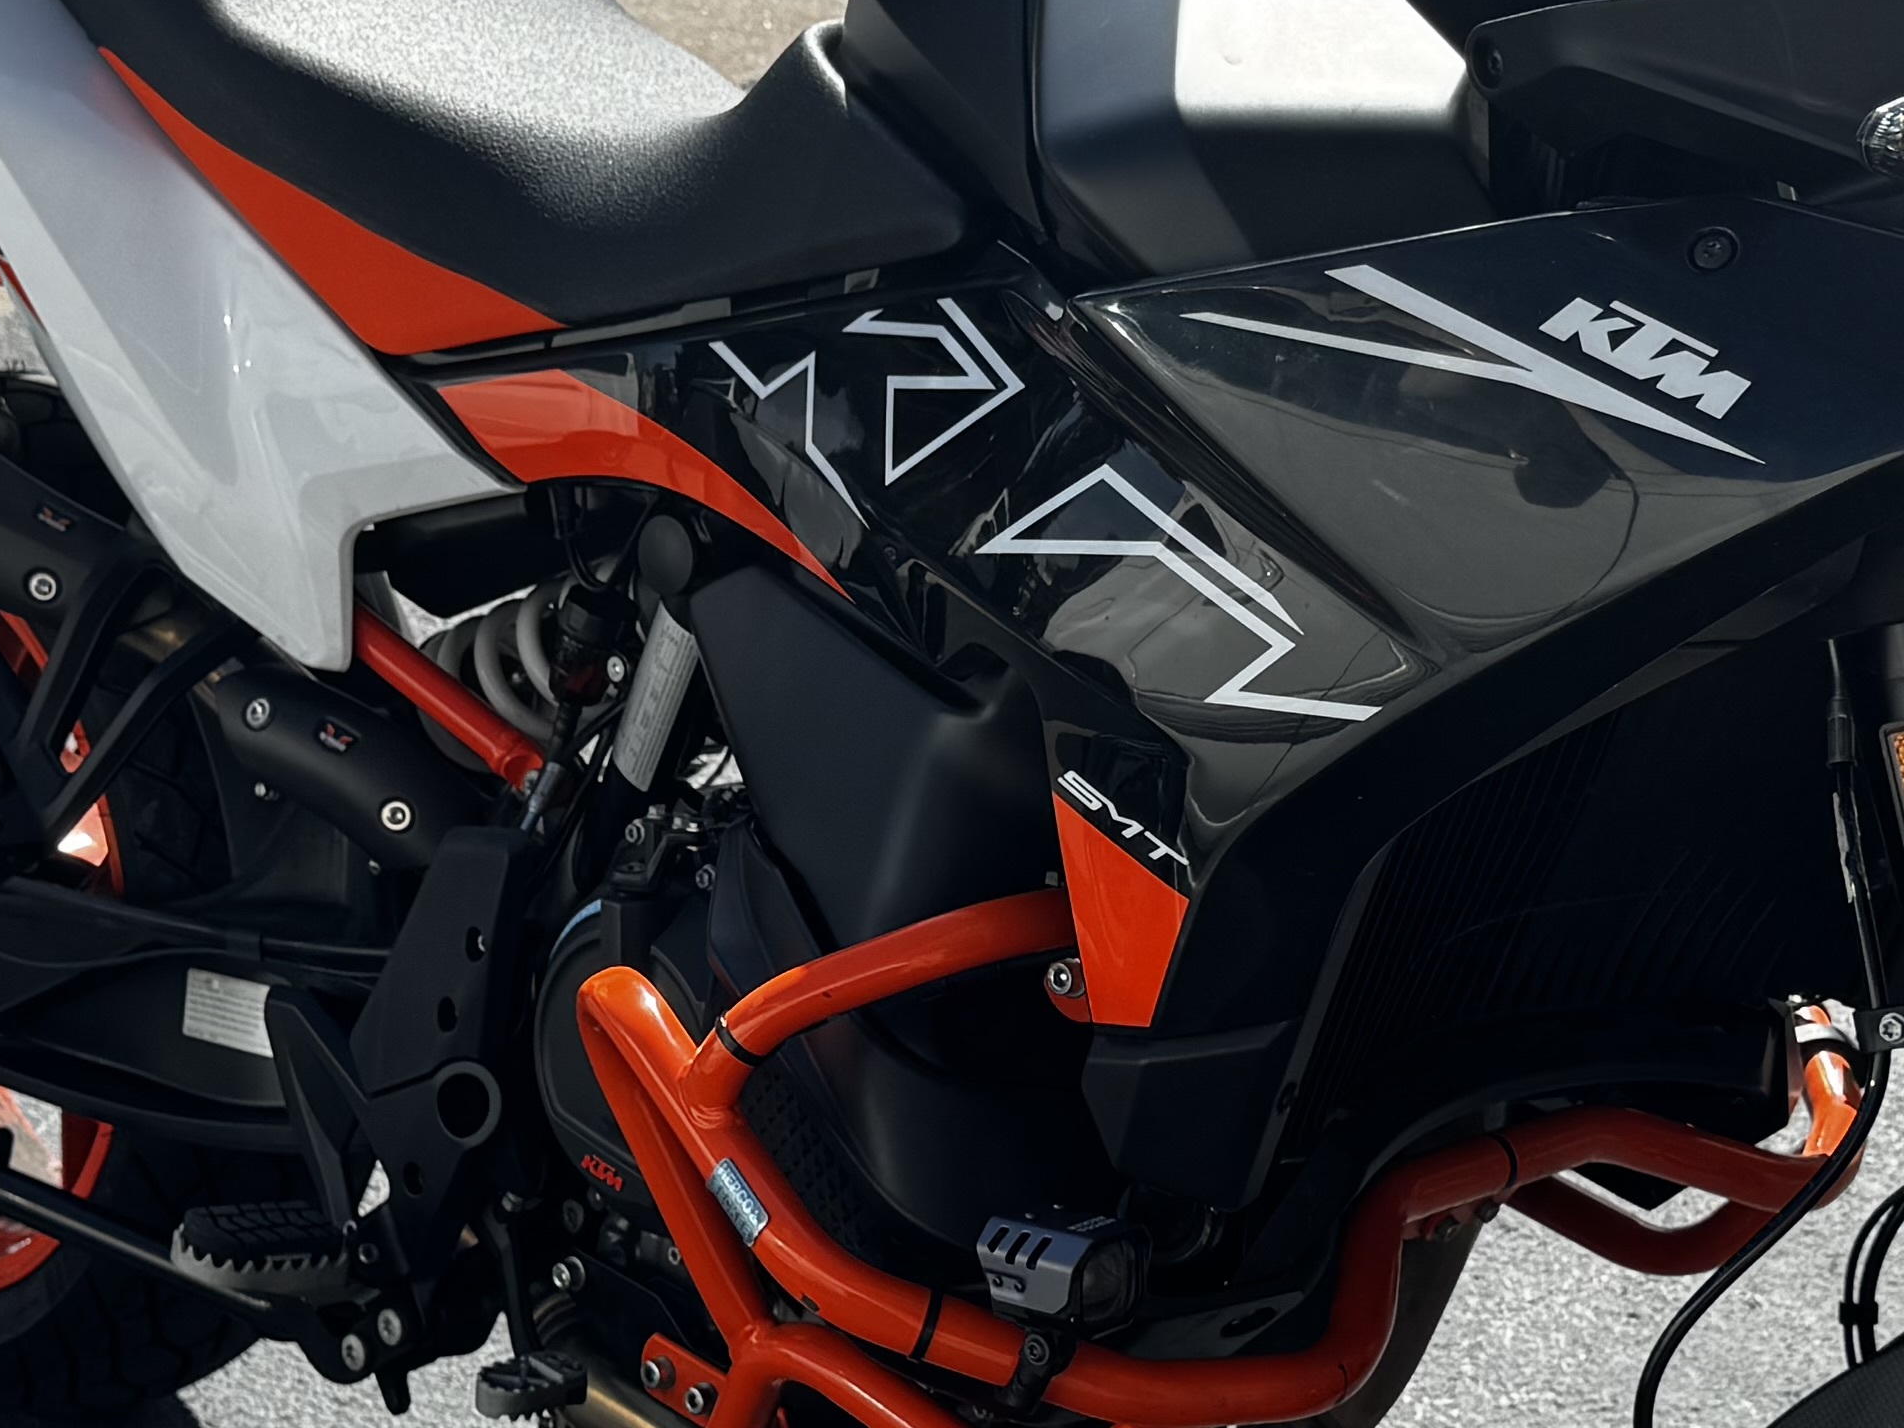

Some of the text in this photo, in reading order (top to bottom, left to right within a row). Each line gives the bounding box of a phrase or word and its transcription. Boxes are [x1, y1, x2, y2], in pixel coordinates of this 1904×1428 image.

[1538, 297, 1752, 420] KTM
[1057, 770, 1190, 866] SMT
[581, 1154, 623, 1192] KTM
[716, 1163, 754, 1214] HEPCO
